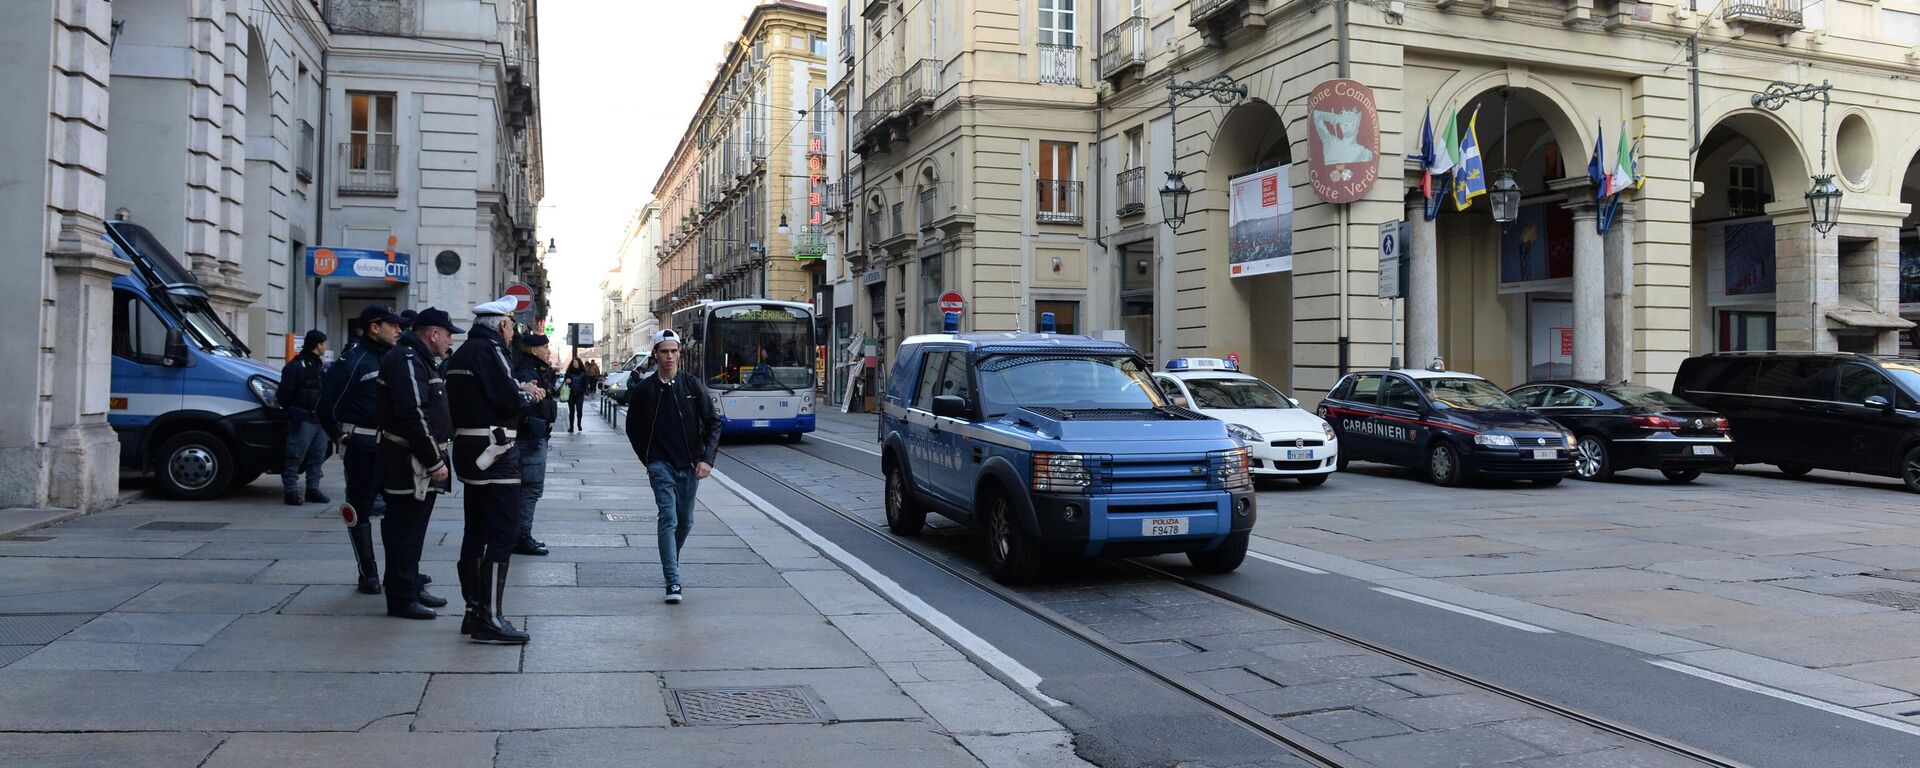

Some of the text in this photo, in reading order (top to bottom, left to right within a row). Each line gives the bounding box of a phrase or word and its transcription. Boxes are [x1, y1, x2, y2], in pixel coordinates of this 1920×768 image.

[1309, 165, 1377, 199] Conte Verde
[356, 263, 384, 273] Informa
[1342, 418, 1406, 440] CARABINIERI
[908, 432, 954, 469] POLIZIA
[1152, 518, 1179, 526] POLIZIA
[1152, 525, 1179, 535] F9478
